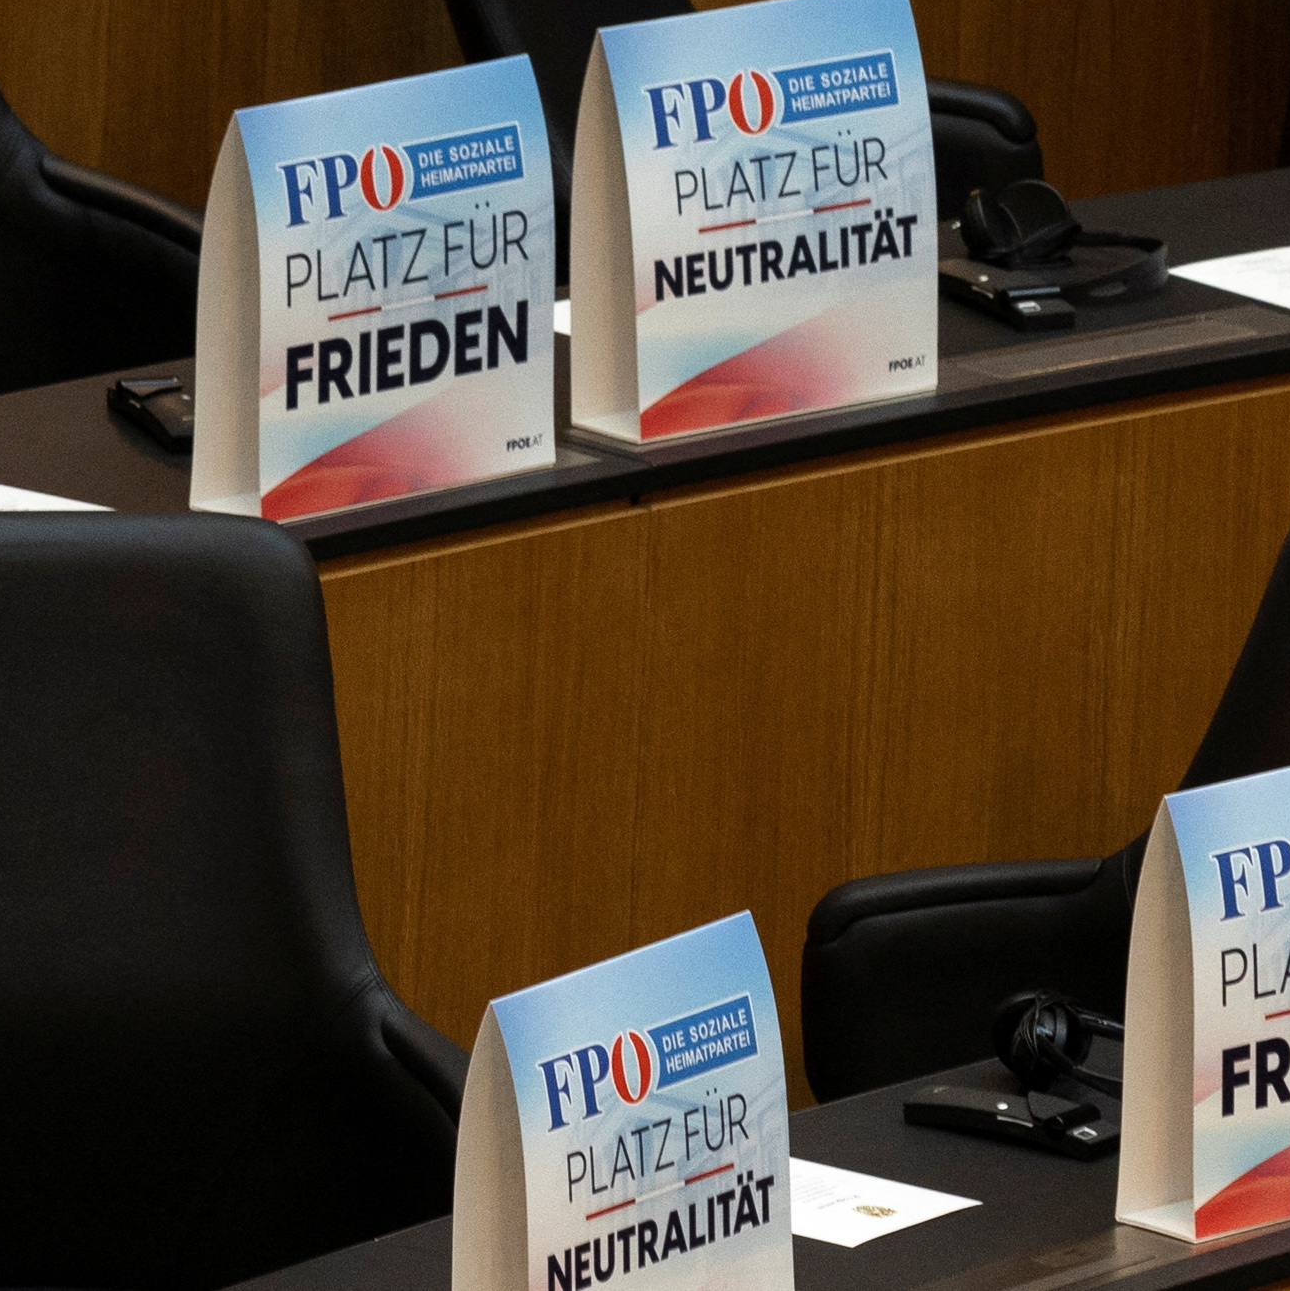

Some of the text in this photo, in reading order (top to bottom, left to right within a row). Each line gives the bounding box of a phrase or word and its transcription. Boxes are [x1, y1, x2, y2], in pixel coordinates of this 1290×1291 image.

[788, 62, 888, 94] DIE SOZIALE
[791, 82, 892, 113] HEIMATPARTEI
[418, 136, 514, 168] DIE SOZIALE
[420, 156, 517, 188] HEIMATPARTEI
[674, 130, 888, 216] PLATZ FÜR
[286, 201, 529, 308] PLATZ FÜR
[654, 208, 917, 302] NEUTRALITÄT
[286, 299, 528, 411] FRIEDEN
[661, 1007, 748, 1054] DIE SOZIALE
[665, 1030, 752, 1074] HEIMATPARTEI
[566, 1088, 748, 1203] PLATZ FÜR
[546, 1170, 773, 1291] NEUTRALITÄT
